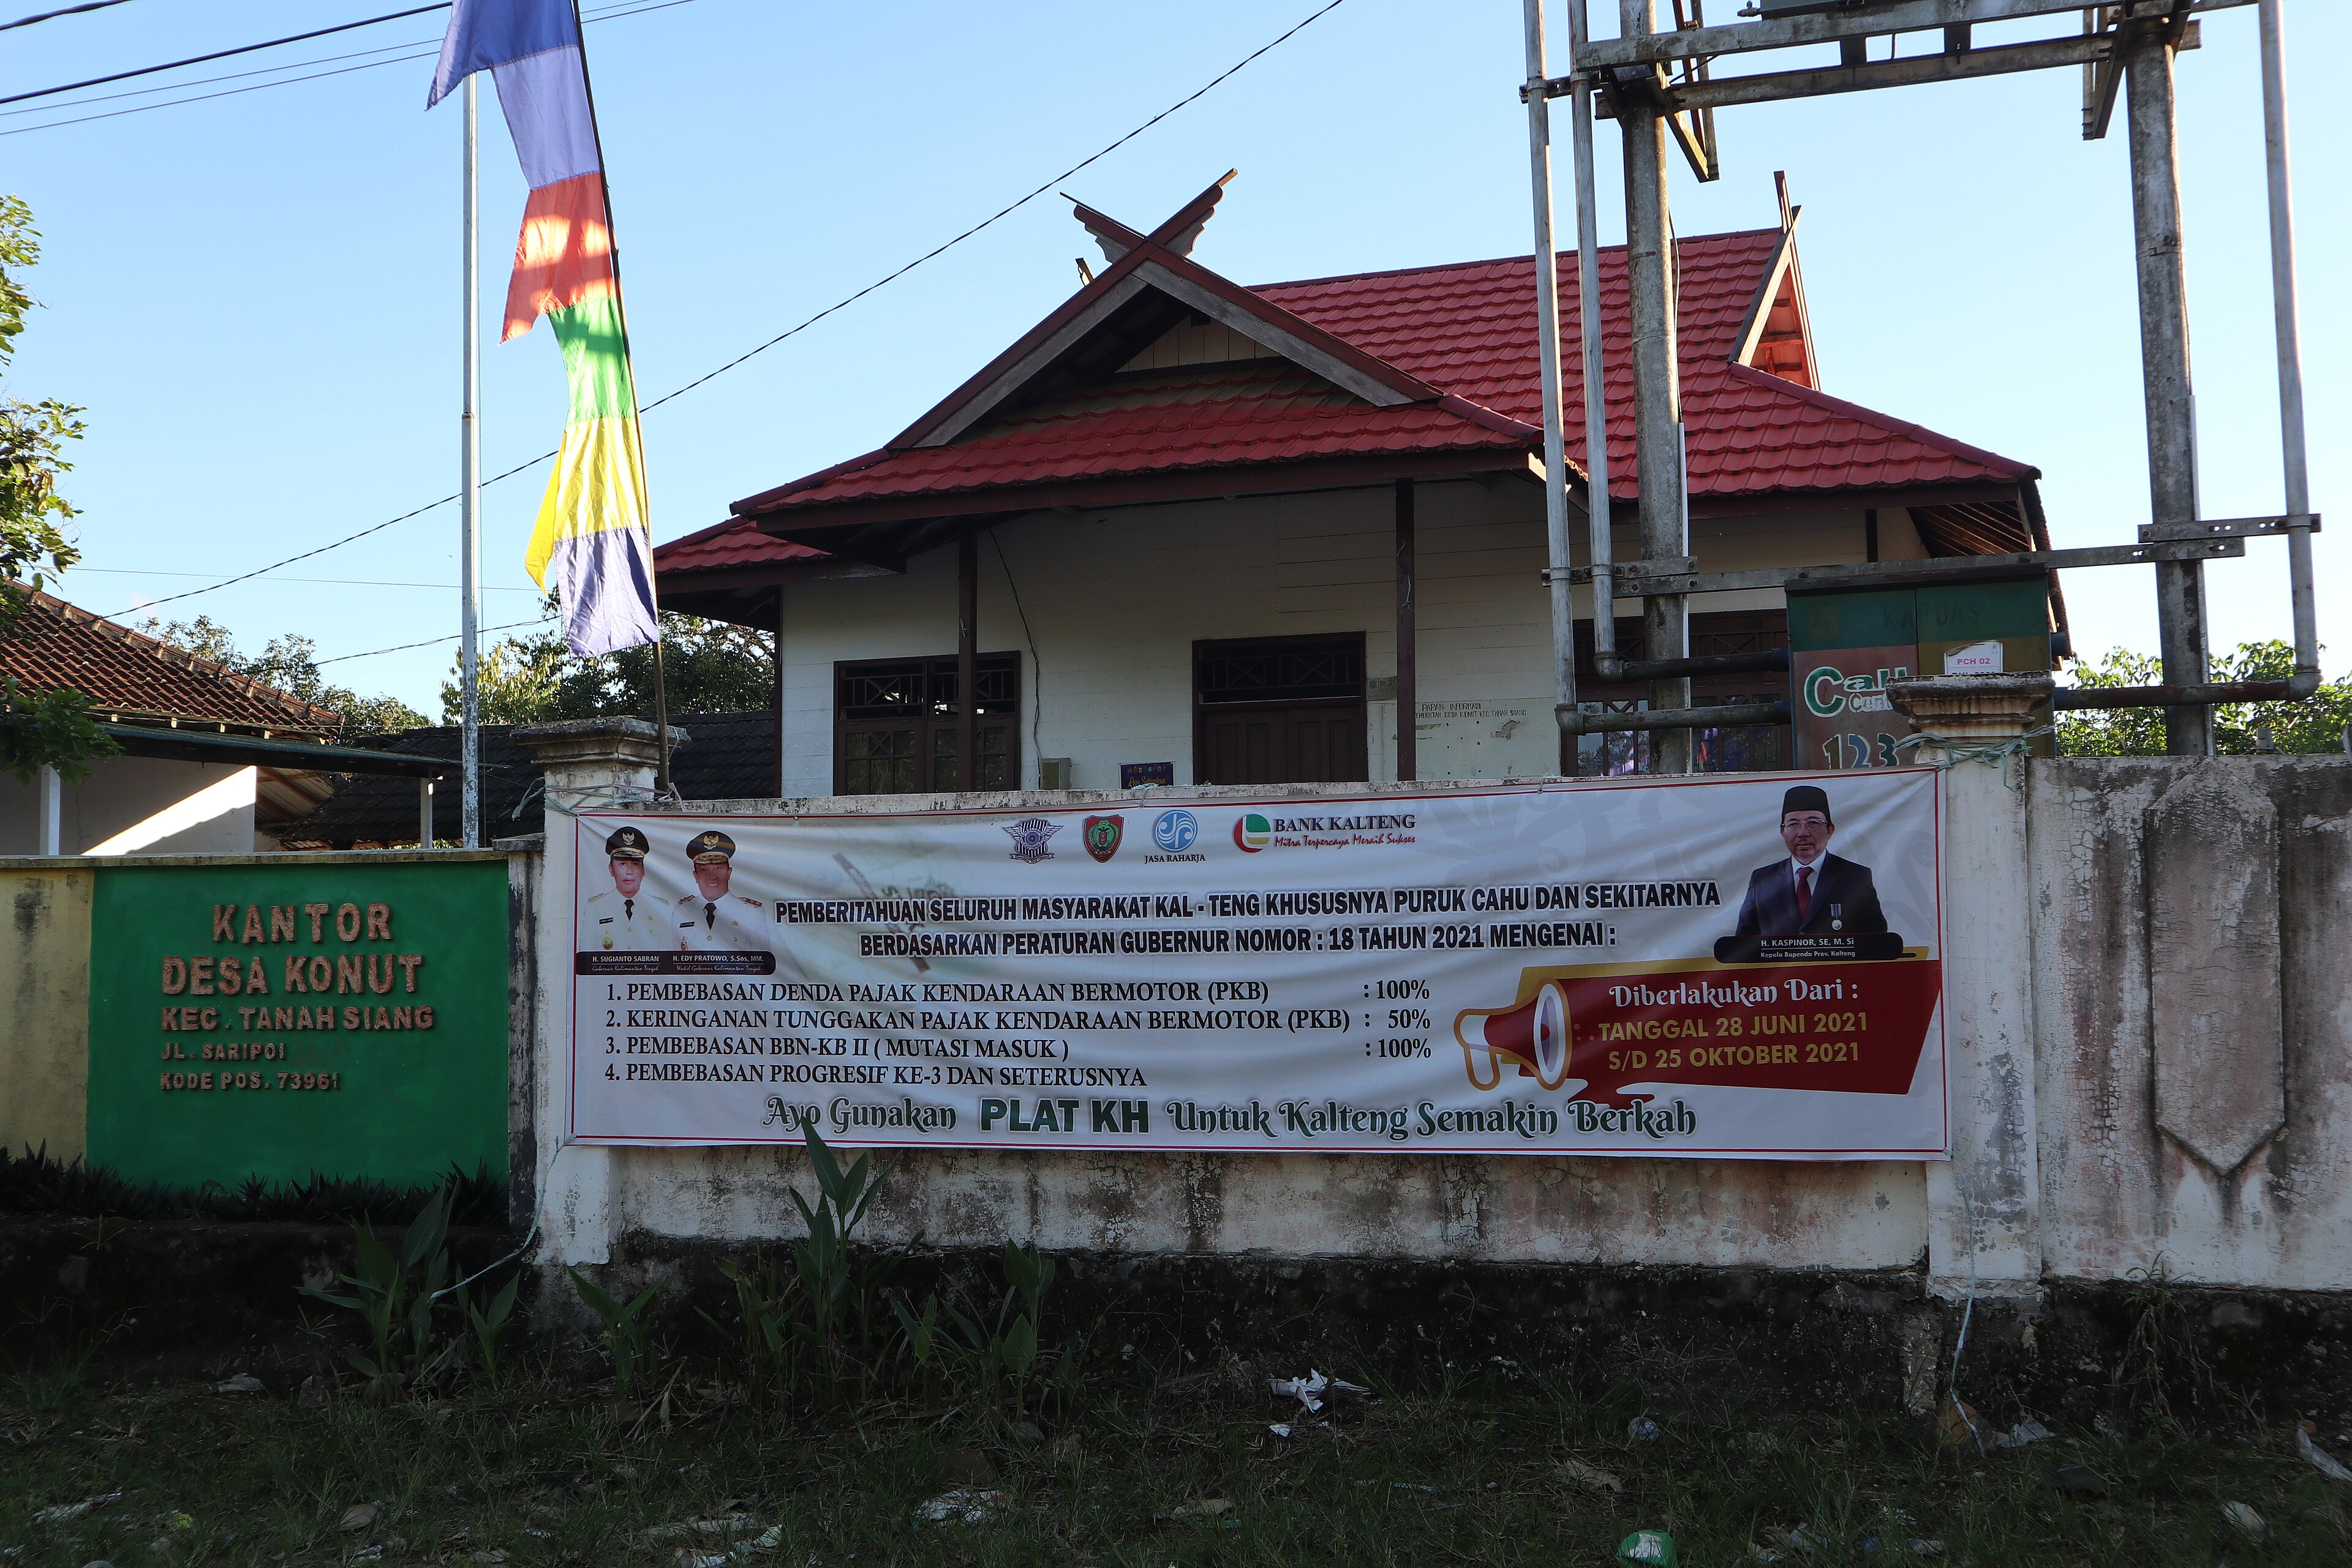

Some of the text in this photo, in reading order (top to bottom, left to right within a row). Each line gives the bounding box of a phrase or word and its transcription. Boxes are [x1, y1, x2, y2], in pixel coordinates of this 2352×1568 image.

[1275, 814, 1416, 832] BANK KALTENG
[1275, 833, 1416, 850] Mitra Terpercaya Meraih Sukses
[1144, 854, 1206, 864] JASA RAHARJA
[776, 901, 925, 923] PEMBERITAHUAN
[930, 899, 1016, 921] SELURUH
[1023, 896, 1150, 919] MASYARAKAT
[1266, 892, 1389, 916] KHUSUSNYA
[1396, 889, 1466, 913] PURUK
[1472, 886, 1529, 911] CAHU
[1537, 885, 1579, 910] DAN
[1585, 882, 1721, 908] SEKITARNYA
[213, 903, 393, 944] KANTOR
[861, 933, 997, 956] BERDASARKAN
[1003, 932, 1115, 955] PERATURAN
[1120, 930, 1229, 953] GUBERNUR
[1235, 928, 1311, 952] NOMOR
[1329, 928, 1354, 951] 18
[1359, 927, 1428, 950] TAHUN
[1433, 925, 1484, 949] 2021
[1490, 923, 1603, 947] MENGENAI
[1772, 939, 1817, 948] KASPINOR,
[162, 954, 424, 995] DESA KONUT
[606, 984, 621, 1002] 1.
[627, 984, 765, 1001] PEMBEBASAN
[770, 984, 843, 1002] DENDA
[849, 983, 916, 1003] PAJAK
[922, 984, 1065, 1003] KENDARAAN
[1071, 982, 1204, 1002] BERMOTOR
[1208, 981, 1268, 1005] (PKB)
[1376, 979, 1430, 1000] 100%
[1609, 980, 1777, 1008] Diberlakukan
[1784, 978, 1842, 1001] Dari
[239, 1006, 335, 1031] TANAH
[342, 1005, 434, 1030] SIANG
[606, 1011, 621, 1028] 2.
[626, 1010, 768, 1028] KERINGANAN
[774, 1010, 914, 1030] TUNGGAKAN
[920, 1011, 989, 1030] PAJAK
[995, 1011, 1142, 1031] KENDARAAN
[1147, 1009, 1282, 1030] BERMOTOR
[1287, 1009, 1351, 1033] (PKB)
[1387, 1008, 1431, 1029] 50%
[1598, 1012, 1868, 1041] TANGGAL 28 JUNI 2021
[160, 1042, 285, 1060] JL. SARIPOI
[605, 1037, 620, 1055] 3.
[626, 1037, 764, 1057] PEMBEBASAN
[769, 1038, 847, 1057] BBN-KB
[853, 1039, 869, 1057] II
[1378, 1038, 1431, 1059] 100%
[1609, 1042, 1860, 1072] S/D 25 OKTOBER 2021
[160, 1072, 214, 1090] KODE
[277, 1071, 341, 1090] 73961
[605, 1063, 1147, 1087] 4. PEMBEBASAN PROGRESIF KE-3 DAN SETERUSNYA
[763, 1097, 1697, 1140] Ayo Gunakan PLAT KH Untuk Kalteng Semakin Berkah
